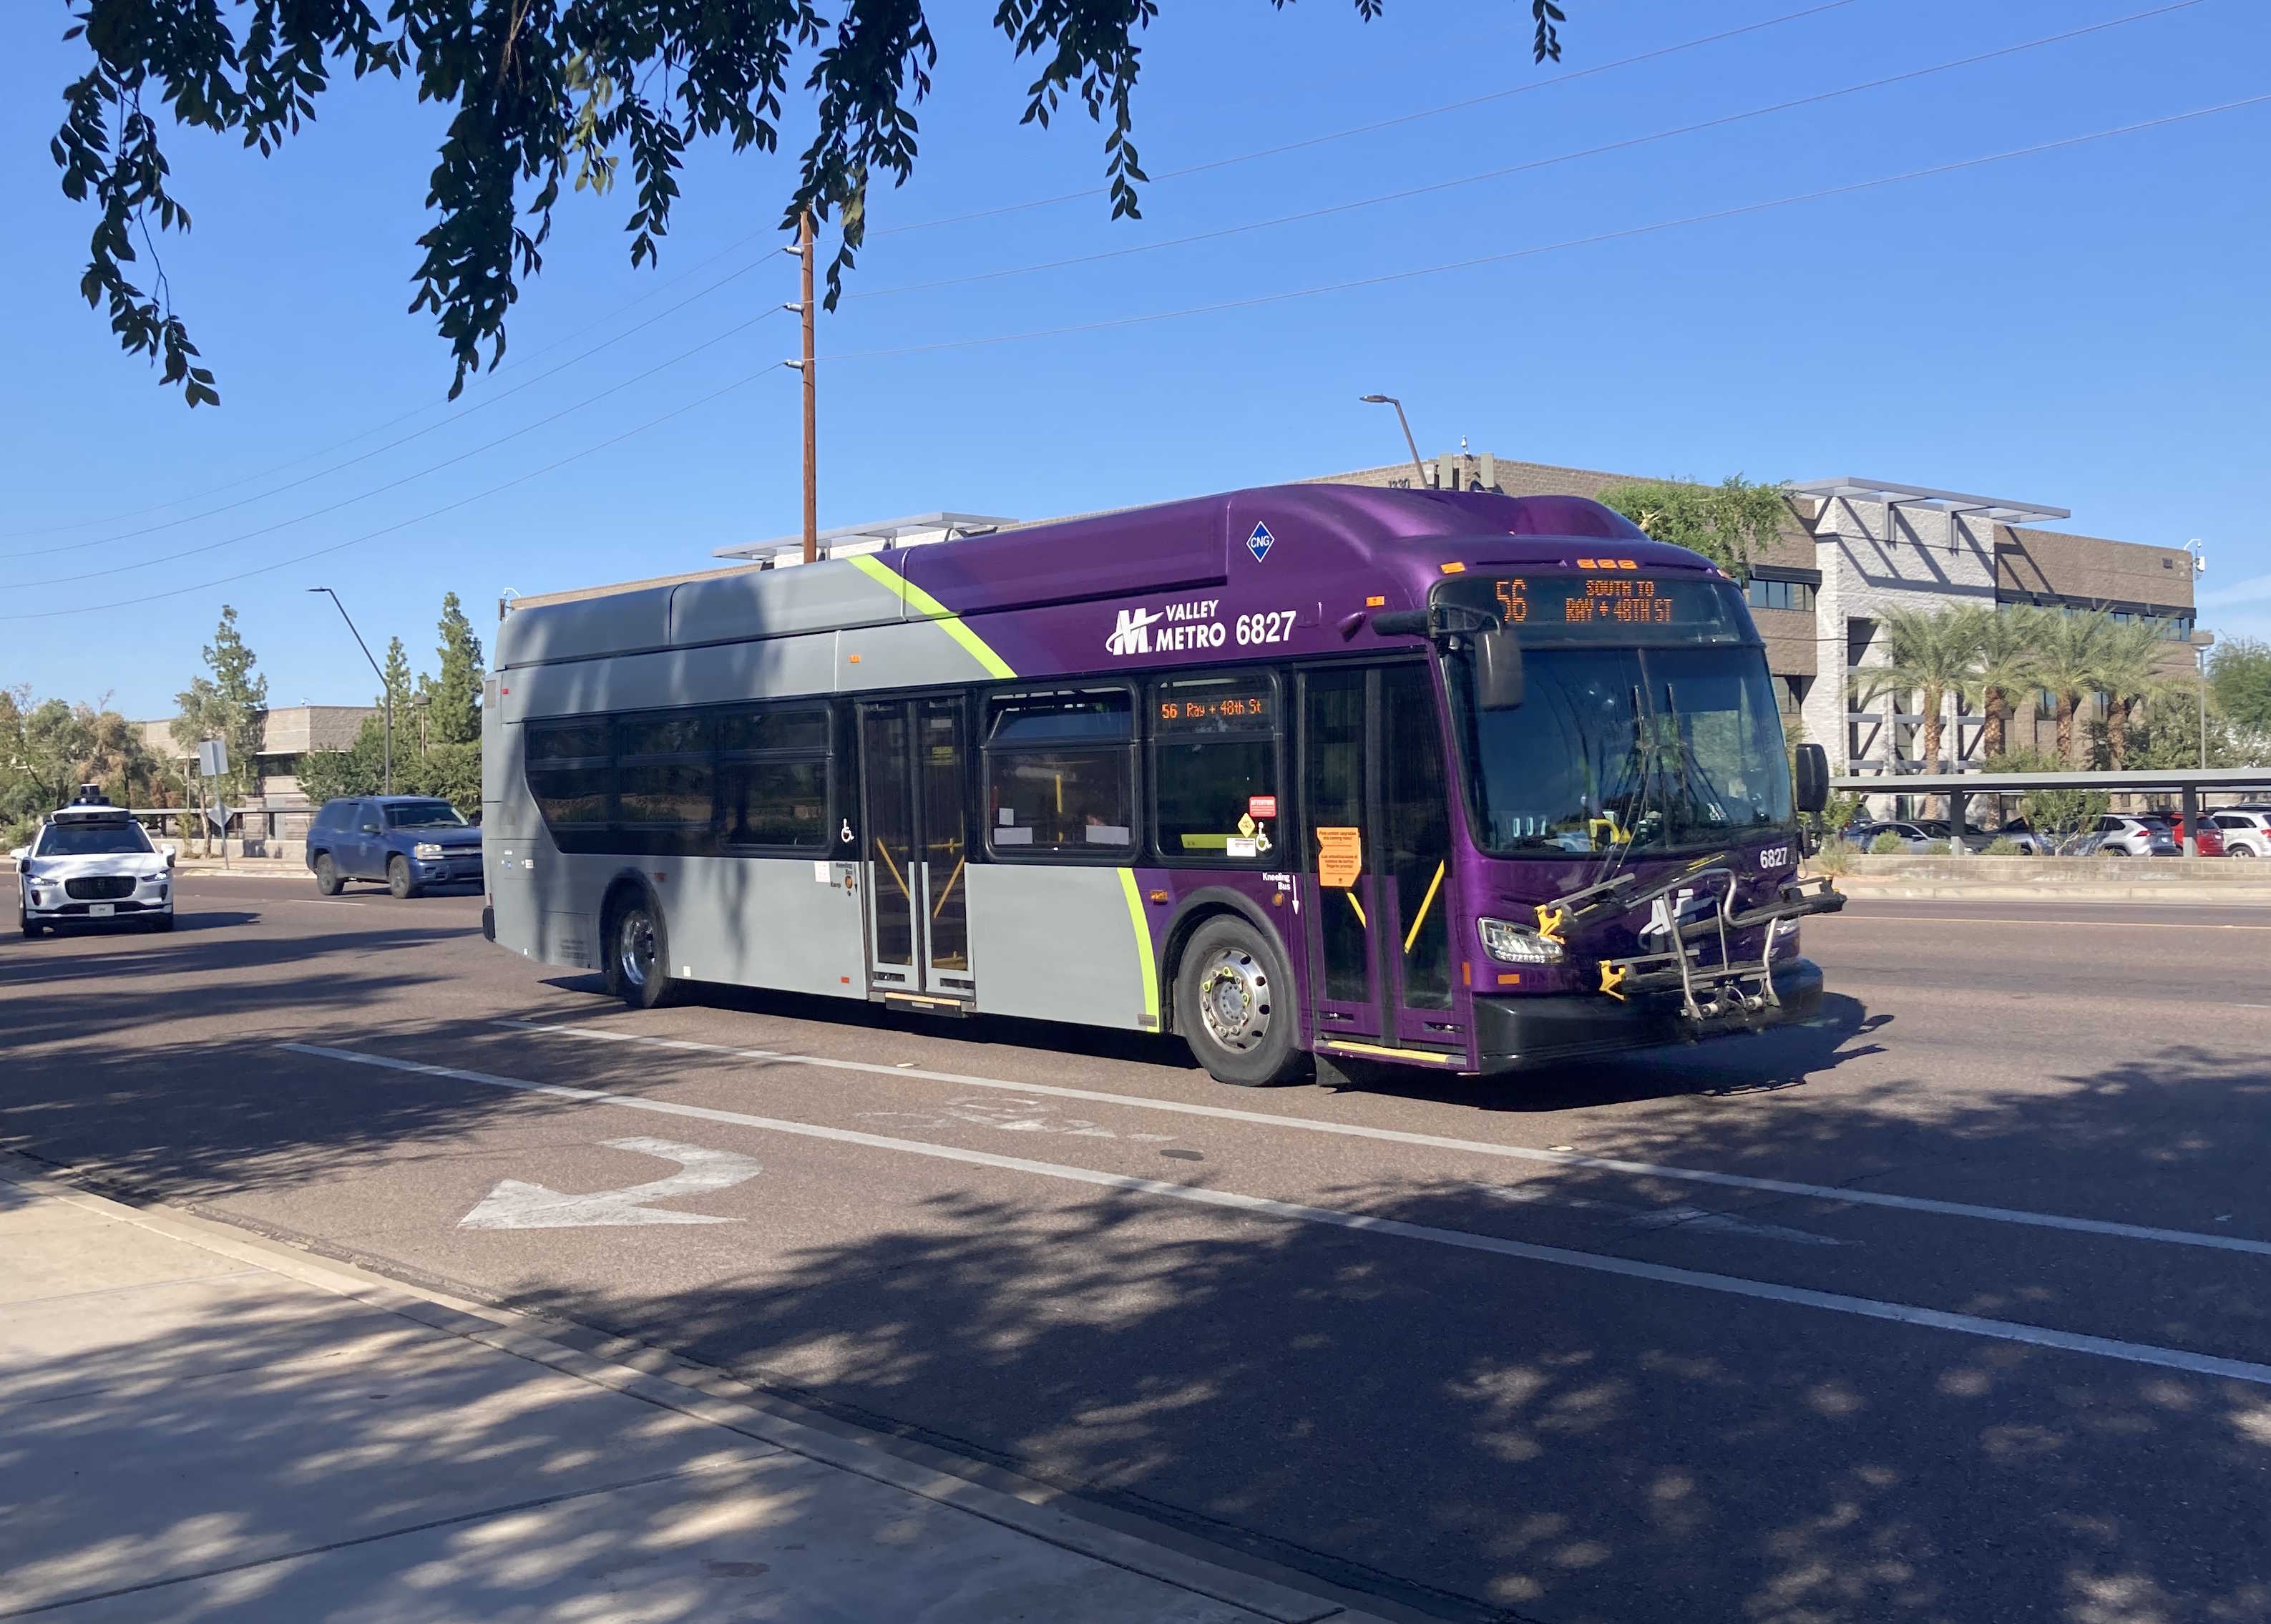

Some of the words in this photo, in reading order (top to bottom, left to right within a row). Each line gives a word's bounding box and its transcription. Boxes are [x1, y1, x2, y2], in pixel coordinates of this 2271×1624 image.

[1250, 534, 1270, 548] CNG
[1586, 579, 1632, 596] SOUTH
[1636, 580, 1655, 597] TO
[1166, 600, 1219, 622] VALLEY
[1495, 579, 1528, 622] 56
[1566, 597, 1594, 622] RAY
[1613, 598, 1650, 622] 48TH
[1654, 598, 1674, 622] ST
[1156, 622, 1226, 652] METRO
[1236, 610, 1296, 646] 6827
[1161, 703, 1178, 719] 56
[1186, 702, 1206, 718] Ray
[1220, 700, 1245, 715] 48th
[1249, 698, 1261, 714] St
[1759, 846, 1788, 869] 6827
[1262, 872, 1291, 883] Kneeling
